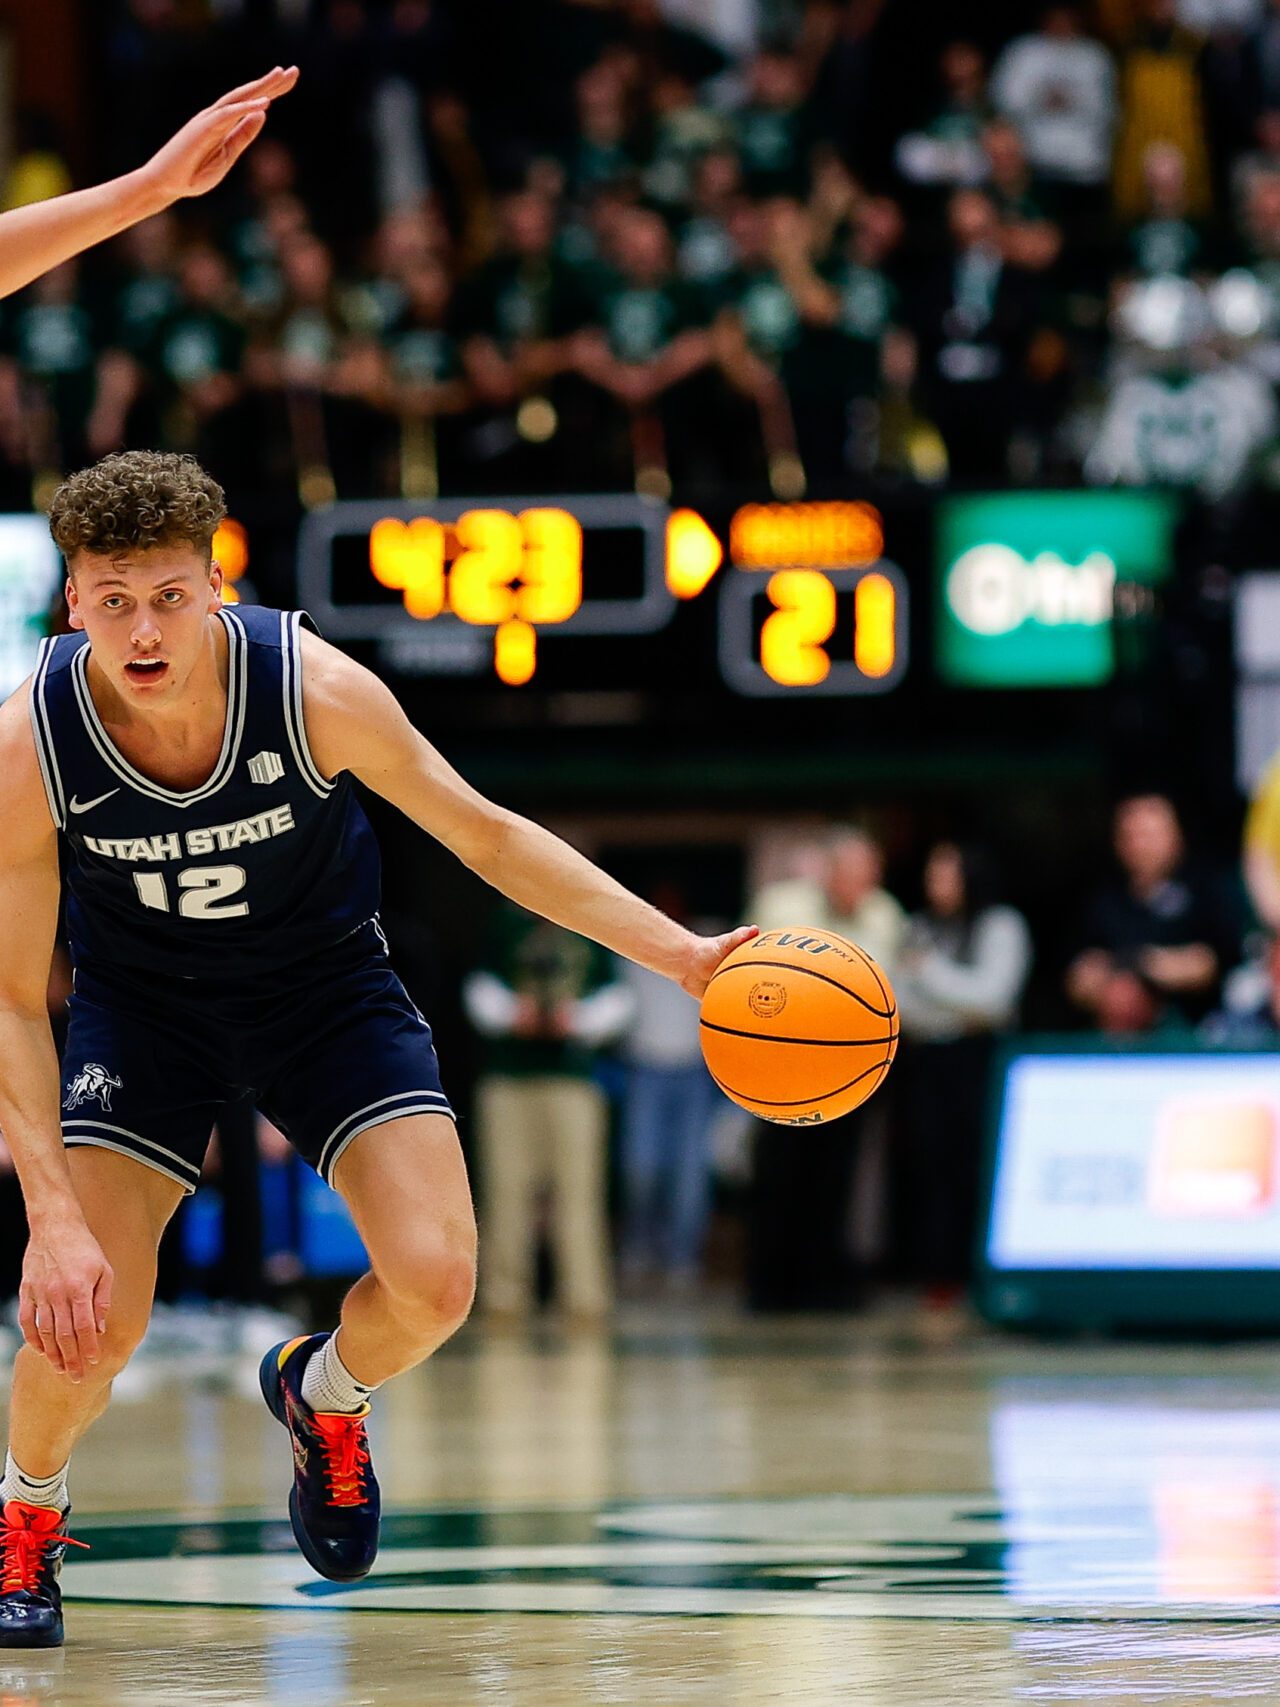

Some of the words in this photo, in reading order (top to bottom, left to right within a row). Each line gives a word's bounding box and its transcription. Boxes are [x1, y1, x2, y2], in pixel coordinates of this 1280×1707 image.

[761, 568, 895, 687] 21
[83, 834, 183, 862] UTAH
[185, 803, 296, 856] STATE
[132, 864, 250, 920] 12
[751, 933, 833, 955] EVO
